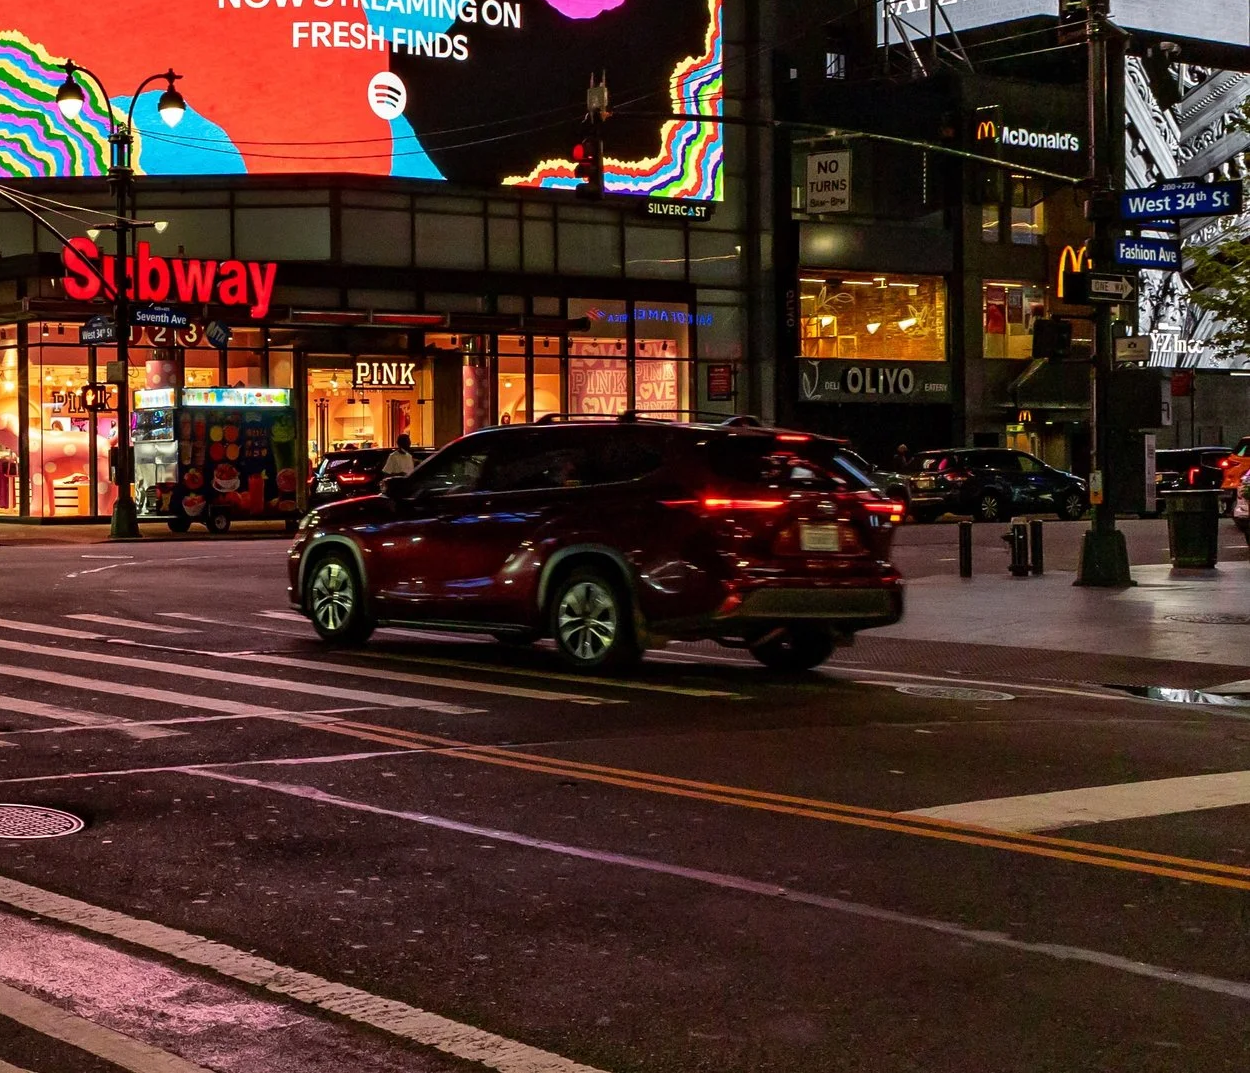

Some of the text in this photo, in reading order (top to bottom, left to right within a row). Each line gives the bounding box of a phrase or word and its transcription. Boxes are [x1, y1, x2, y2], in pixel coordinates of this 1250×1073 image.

[483, 0, 521, 28] ON
[292, 21, 469, 61] FRESH FINDS
[817, 160, 839, 174] NO
[809, 179, 847, 192] TURNS
[648, 203, 706, 217] SILVERCAST
[1129, 191, 1230, 213] West 34th St
[1120, 243, 1177, 263] Fashion Ave
[63, 237, 277, 318] Subway
[136, 311, 187, 325] Seventh Ave
[82, 330, 96, 340] West
[154, 327, 166, 342] 2
[185, 323, 197, 343] 3
[356, 362, 416, 385] PINK
[572, 370, 627, 395] PINK
[847, 366, 914, 394] OLIYO
[824, 382, 840, 391] DELI
